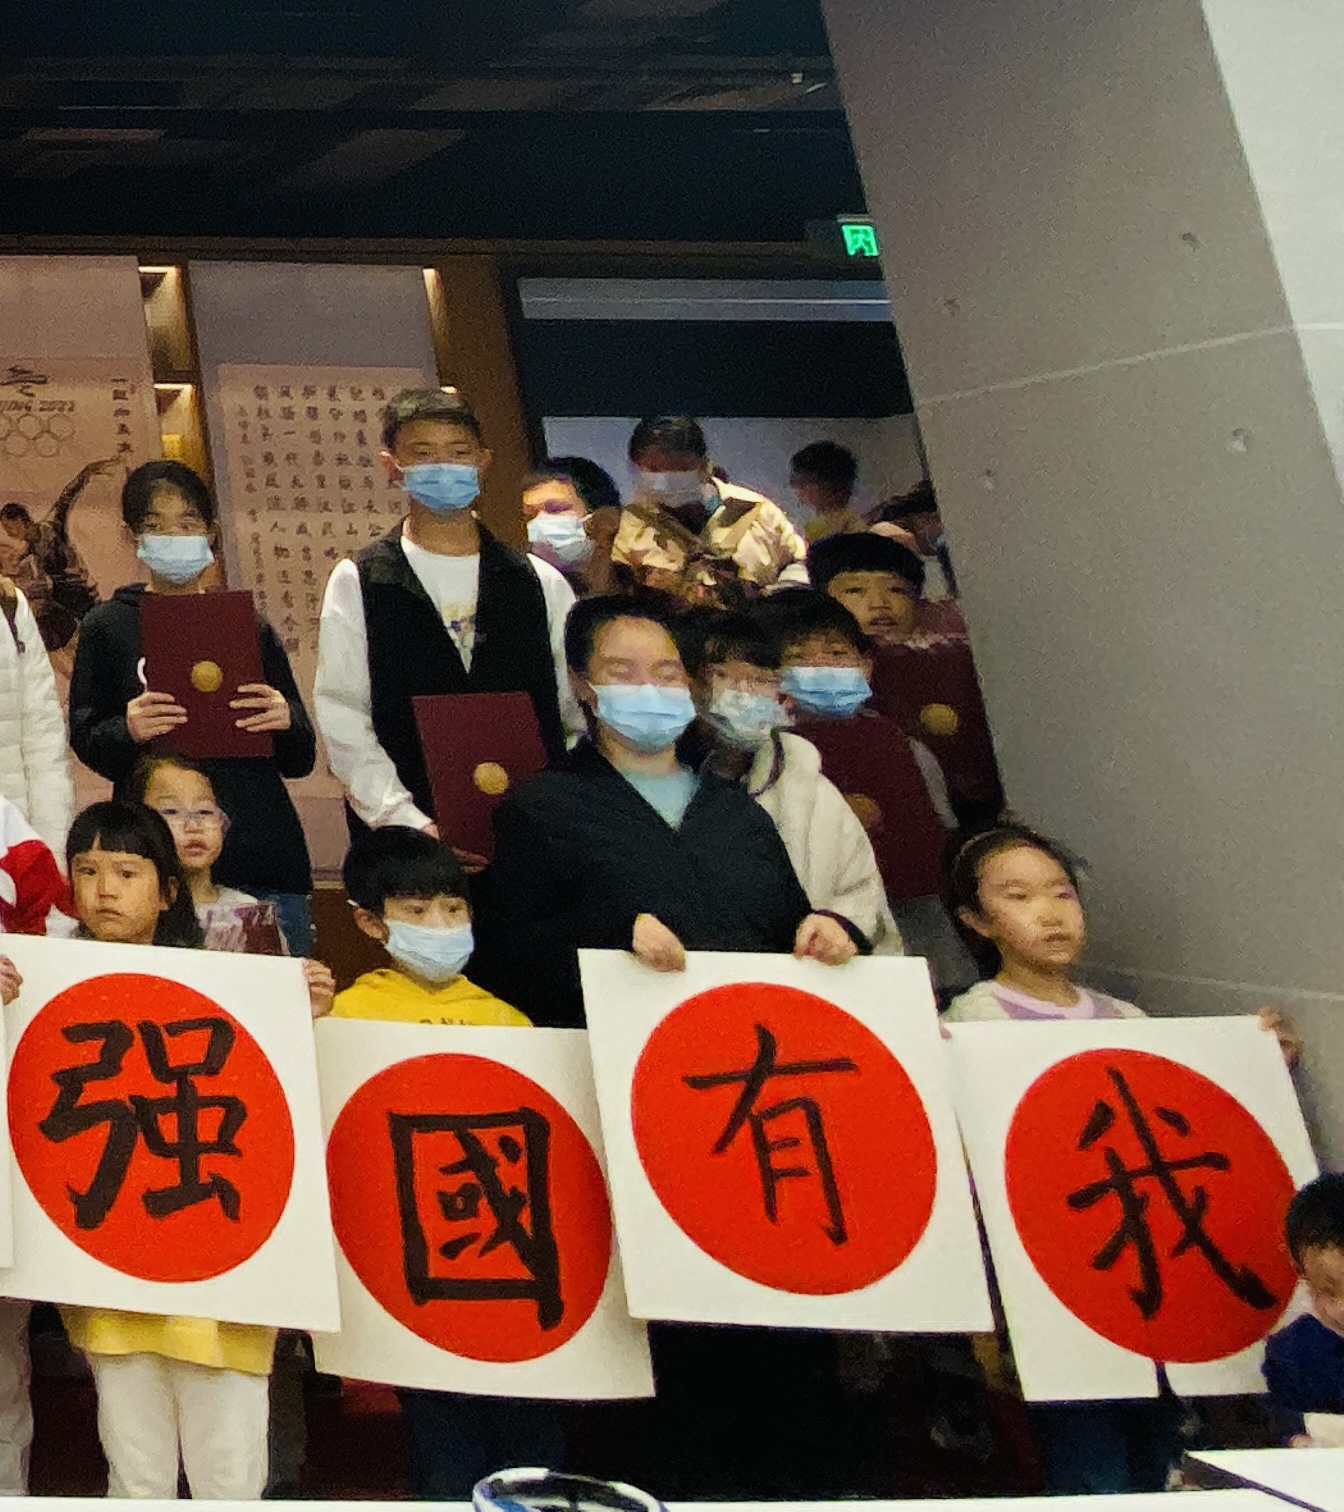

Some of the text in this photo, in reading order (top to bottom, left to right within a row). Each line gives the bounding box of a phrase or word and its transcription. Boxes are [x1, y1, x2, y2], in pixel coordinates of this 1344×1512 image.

[37, 1016, 249, 1232] 强
[385, 1105, 566, 1332] 國
[683, 1022, 858, 1247] 有
[1067, 1065, 1280, 1321] 我
